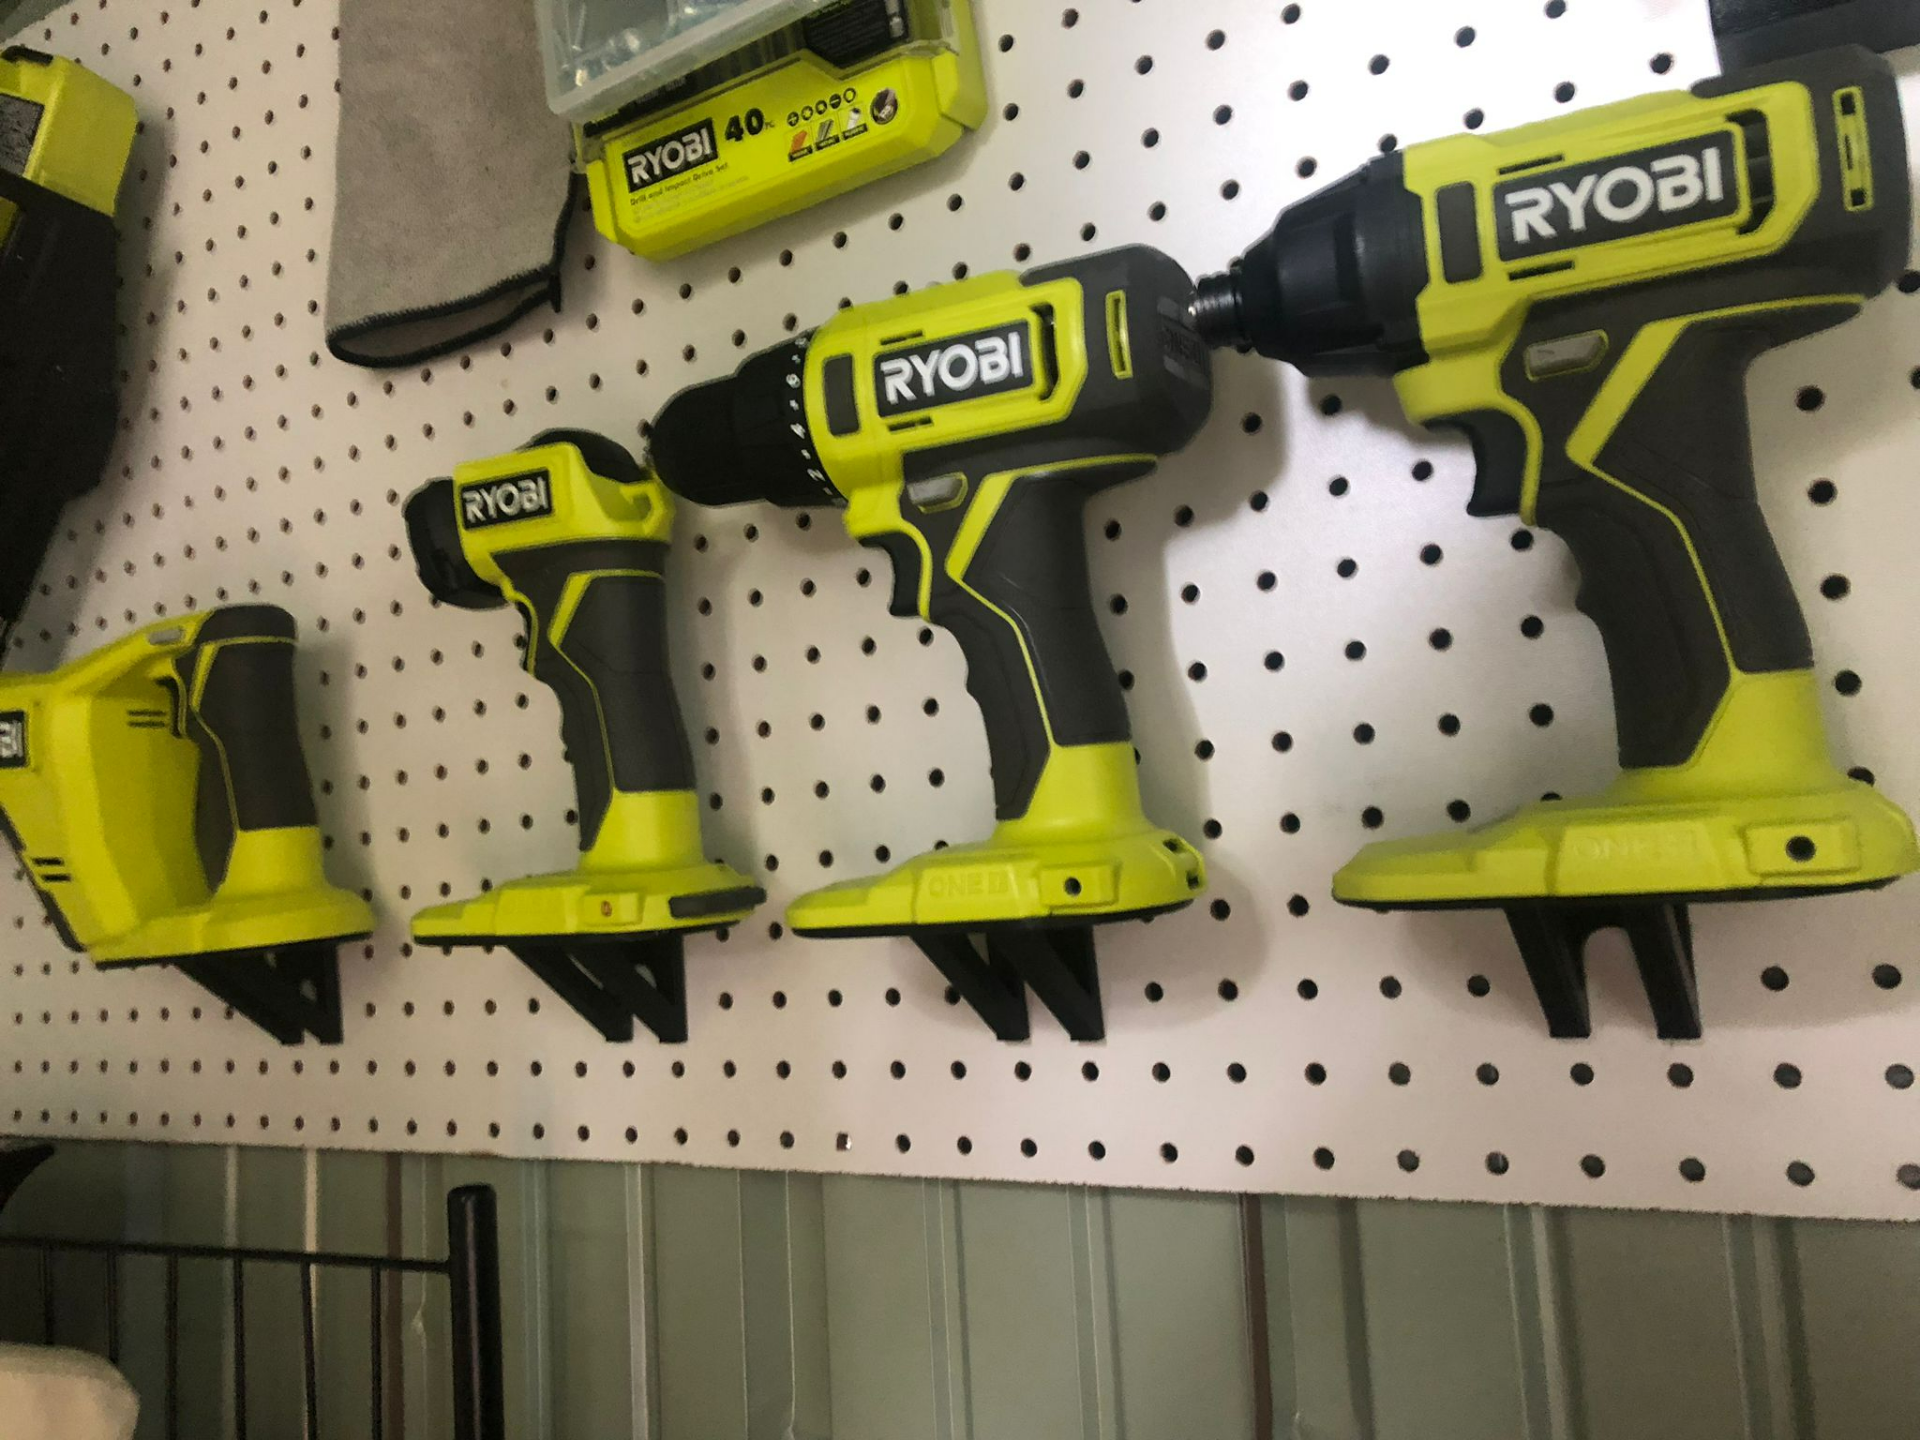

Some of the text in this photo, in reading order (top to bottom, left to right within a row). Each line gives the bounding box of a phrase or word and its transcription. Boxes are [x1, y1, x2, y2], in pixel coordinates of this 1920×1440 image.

[724, 107, 764, 142] 40
[627, 127, 713, 185] RYOBI
[649, 187, 663, 199] and
[664, 176, 692, 191] Impact
[692, 168, 714, 182] Drive
[1504, 146, 1724, 244] RYOBI
[880, 331, 1024, 406] RYOBI
[462, 476, 549, 524] RYOBI
